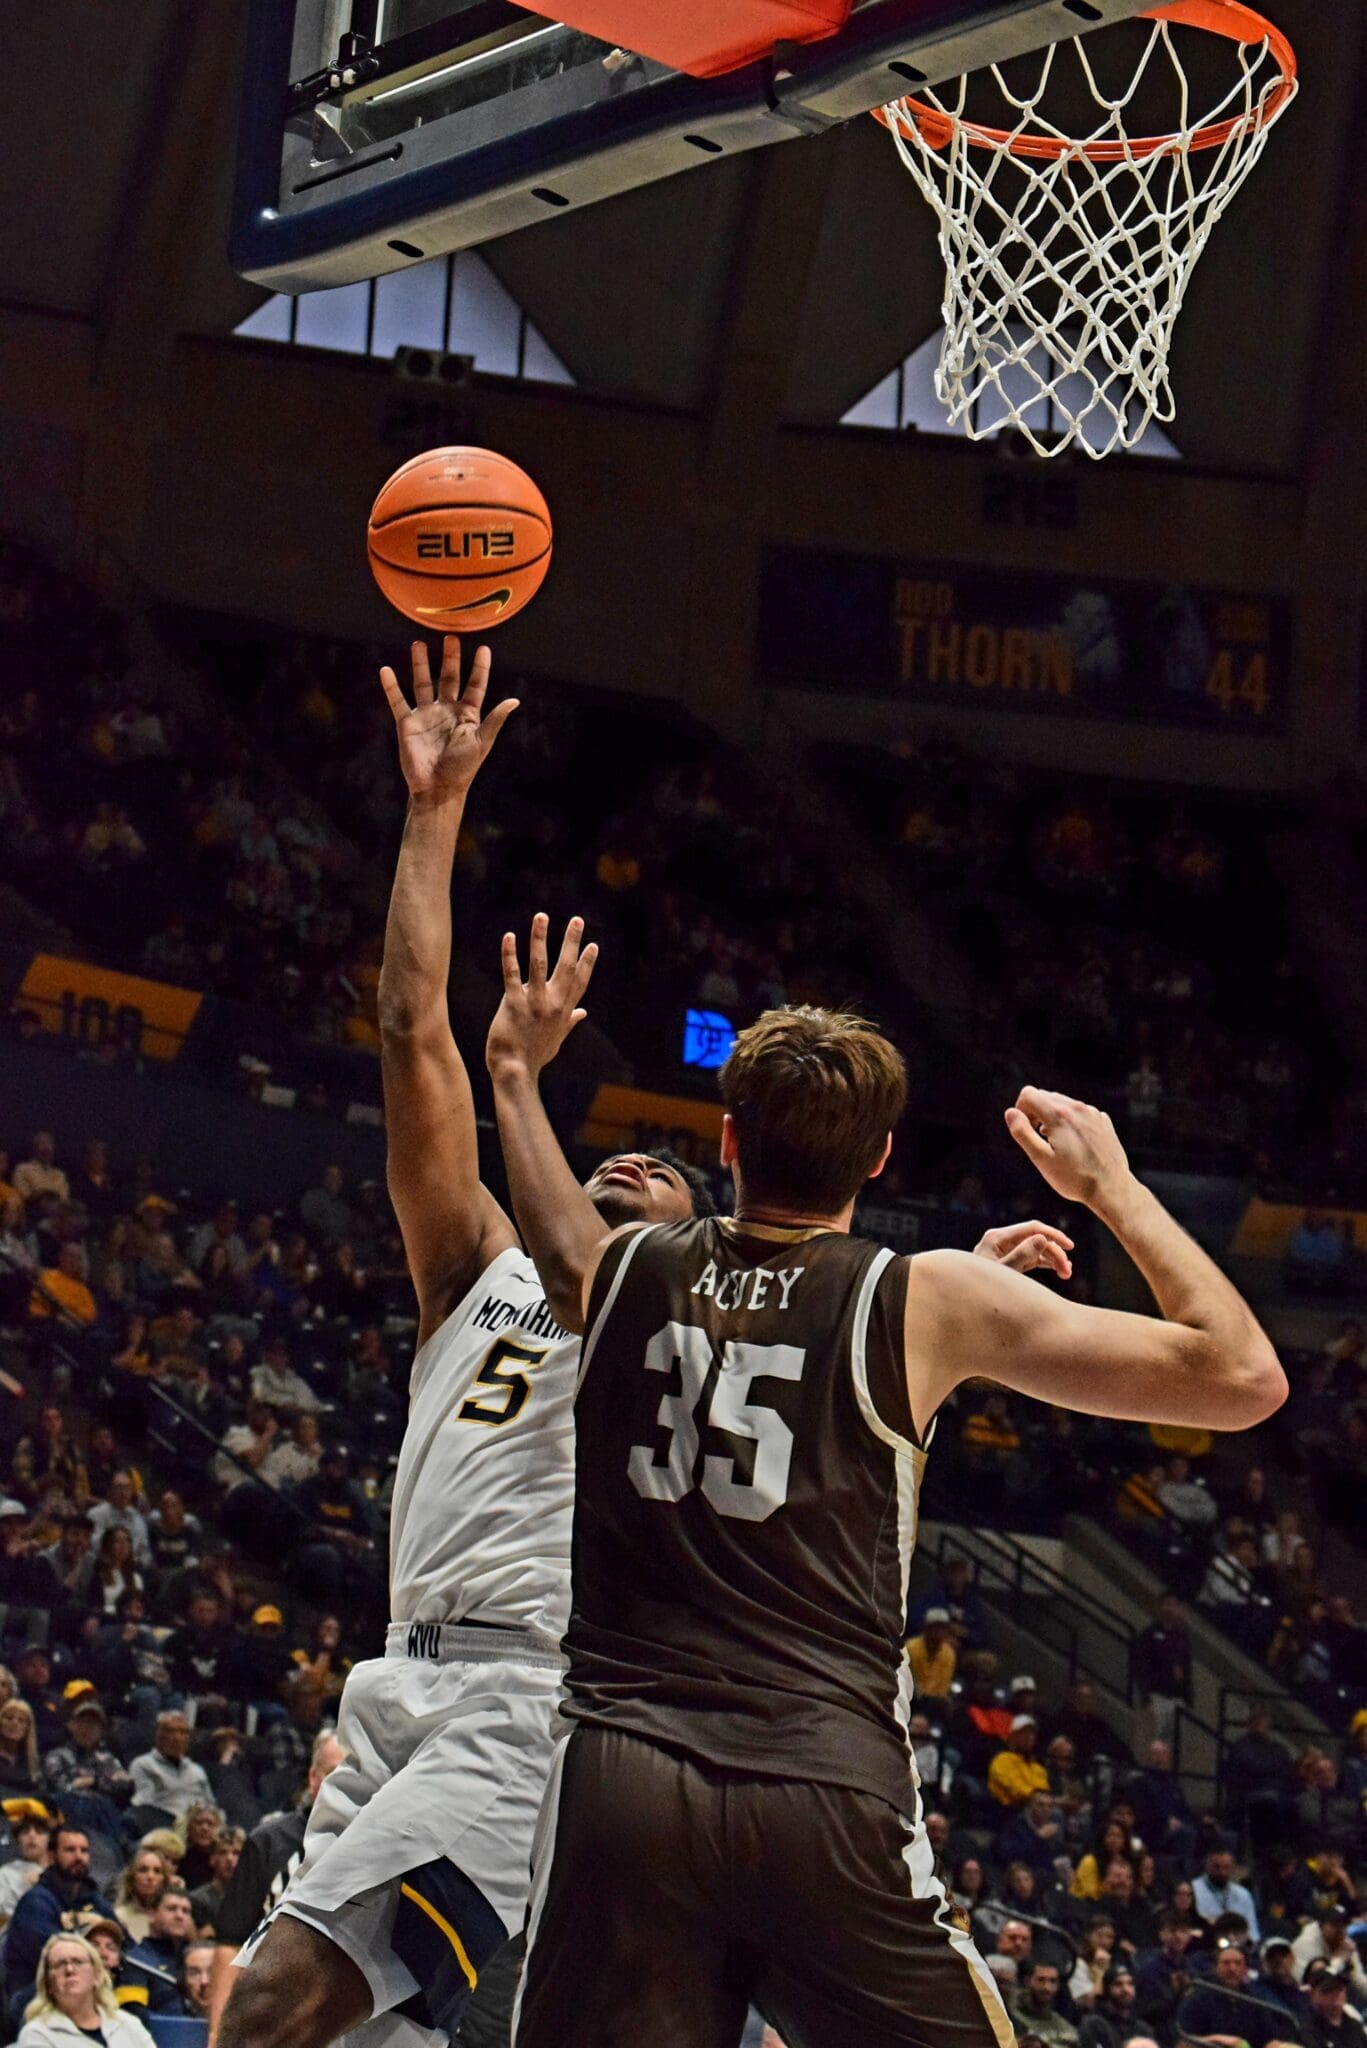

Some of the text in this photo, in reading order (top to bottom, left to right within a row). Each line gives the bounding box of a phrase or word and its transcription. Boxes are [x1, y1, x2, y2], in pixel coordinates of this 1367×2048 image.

[416, 531, 514, 558] ELITE
[895, 616, 1074, 696] THORN
[1206, 647, 1271, 716] 44
[456, 1337, 551, 1427] 5
[627, 1321, 806, 1522] 35
[408, 1624, 441, 1659] WVU
